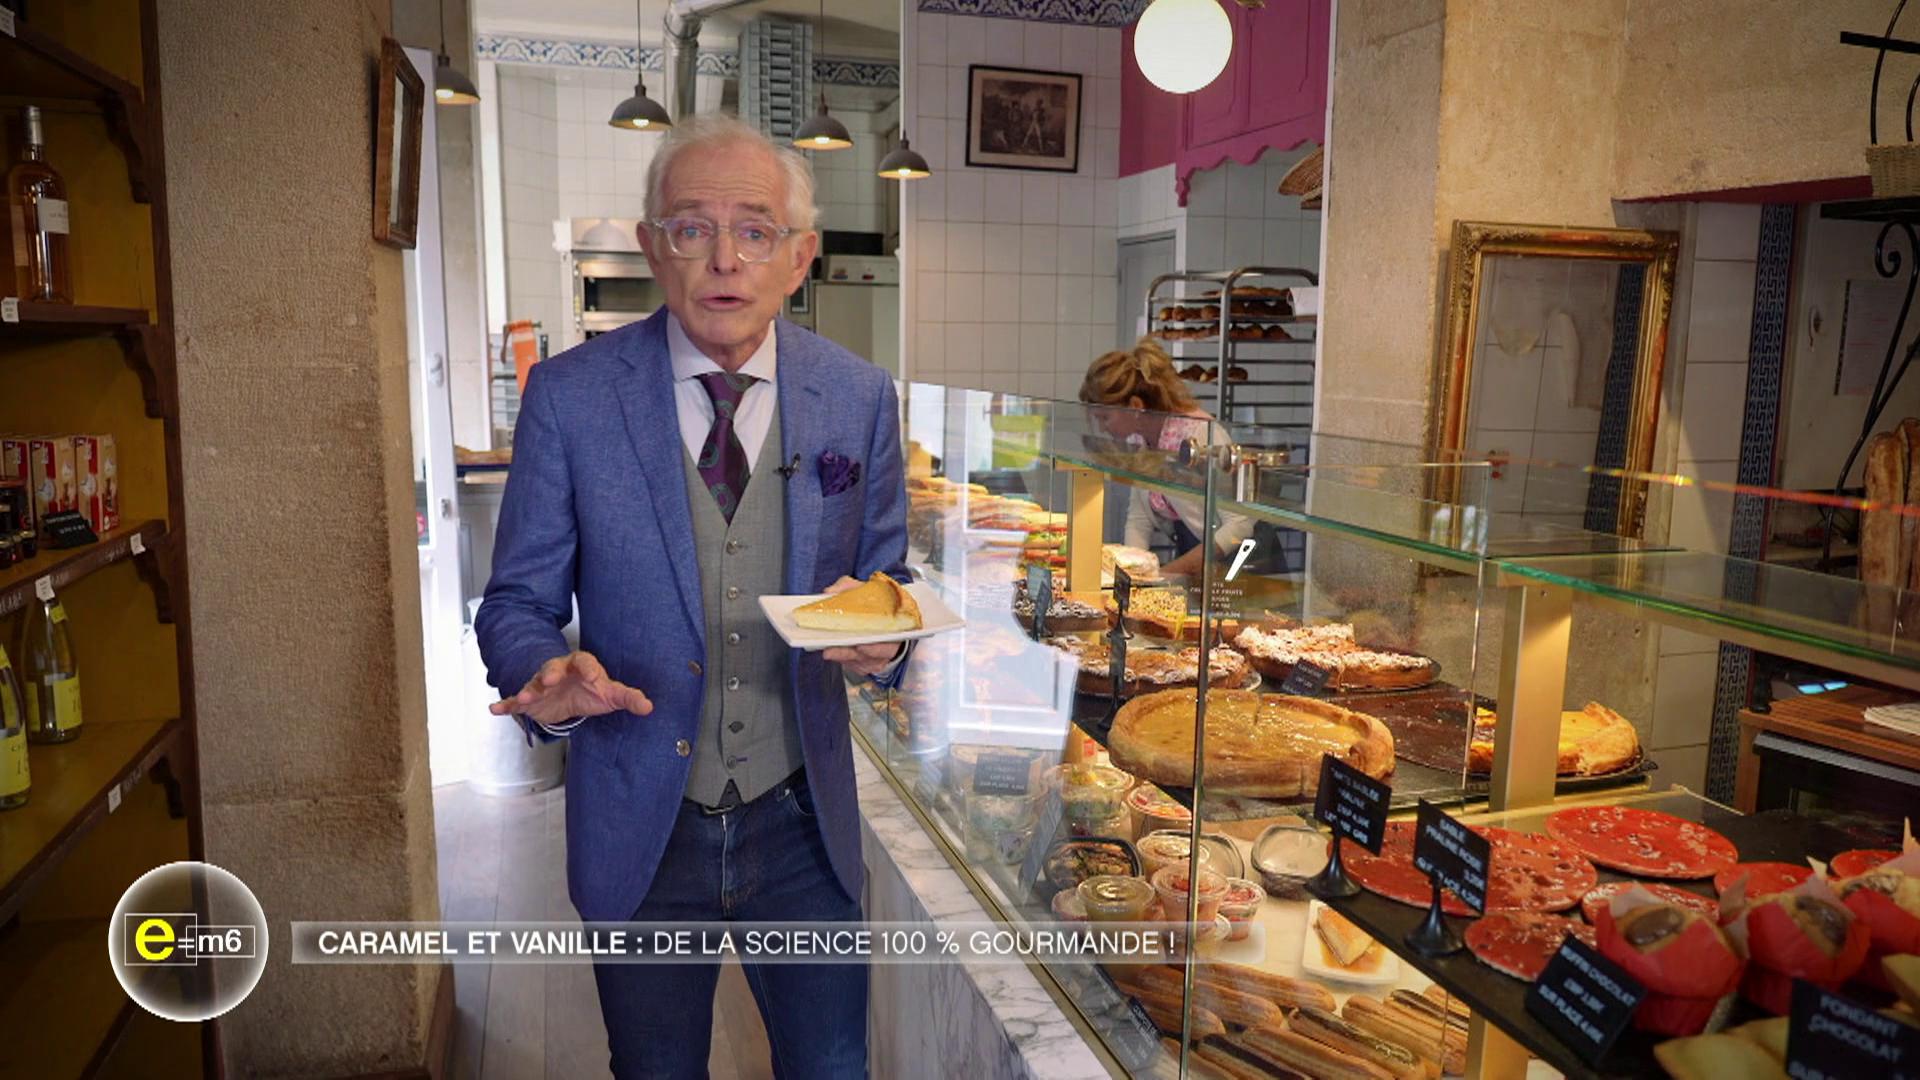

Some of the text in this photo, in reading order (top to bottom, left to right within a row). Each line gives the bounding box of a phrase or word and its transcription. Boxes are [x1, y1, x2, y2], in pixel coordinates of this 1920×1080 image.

[1560, 945, 1637, 1008] MUFFIN CHOCOLAT
[1808, 1013, 1903, 1064] CHOCOLAT
[1820, 994, 1899, 1040] FONDANT
